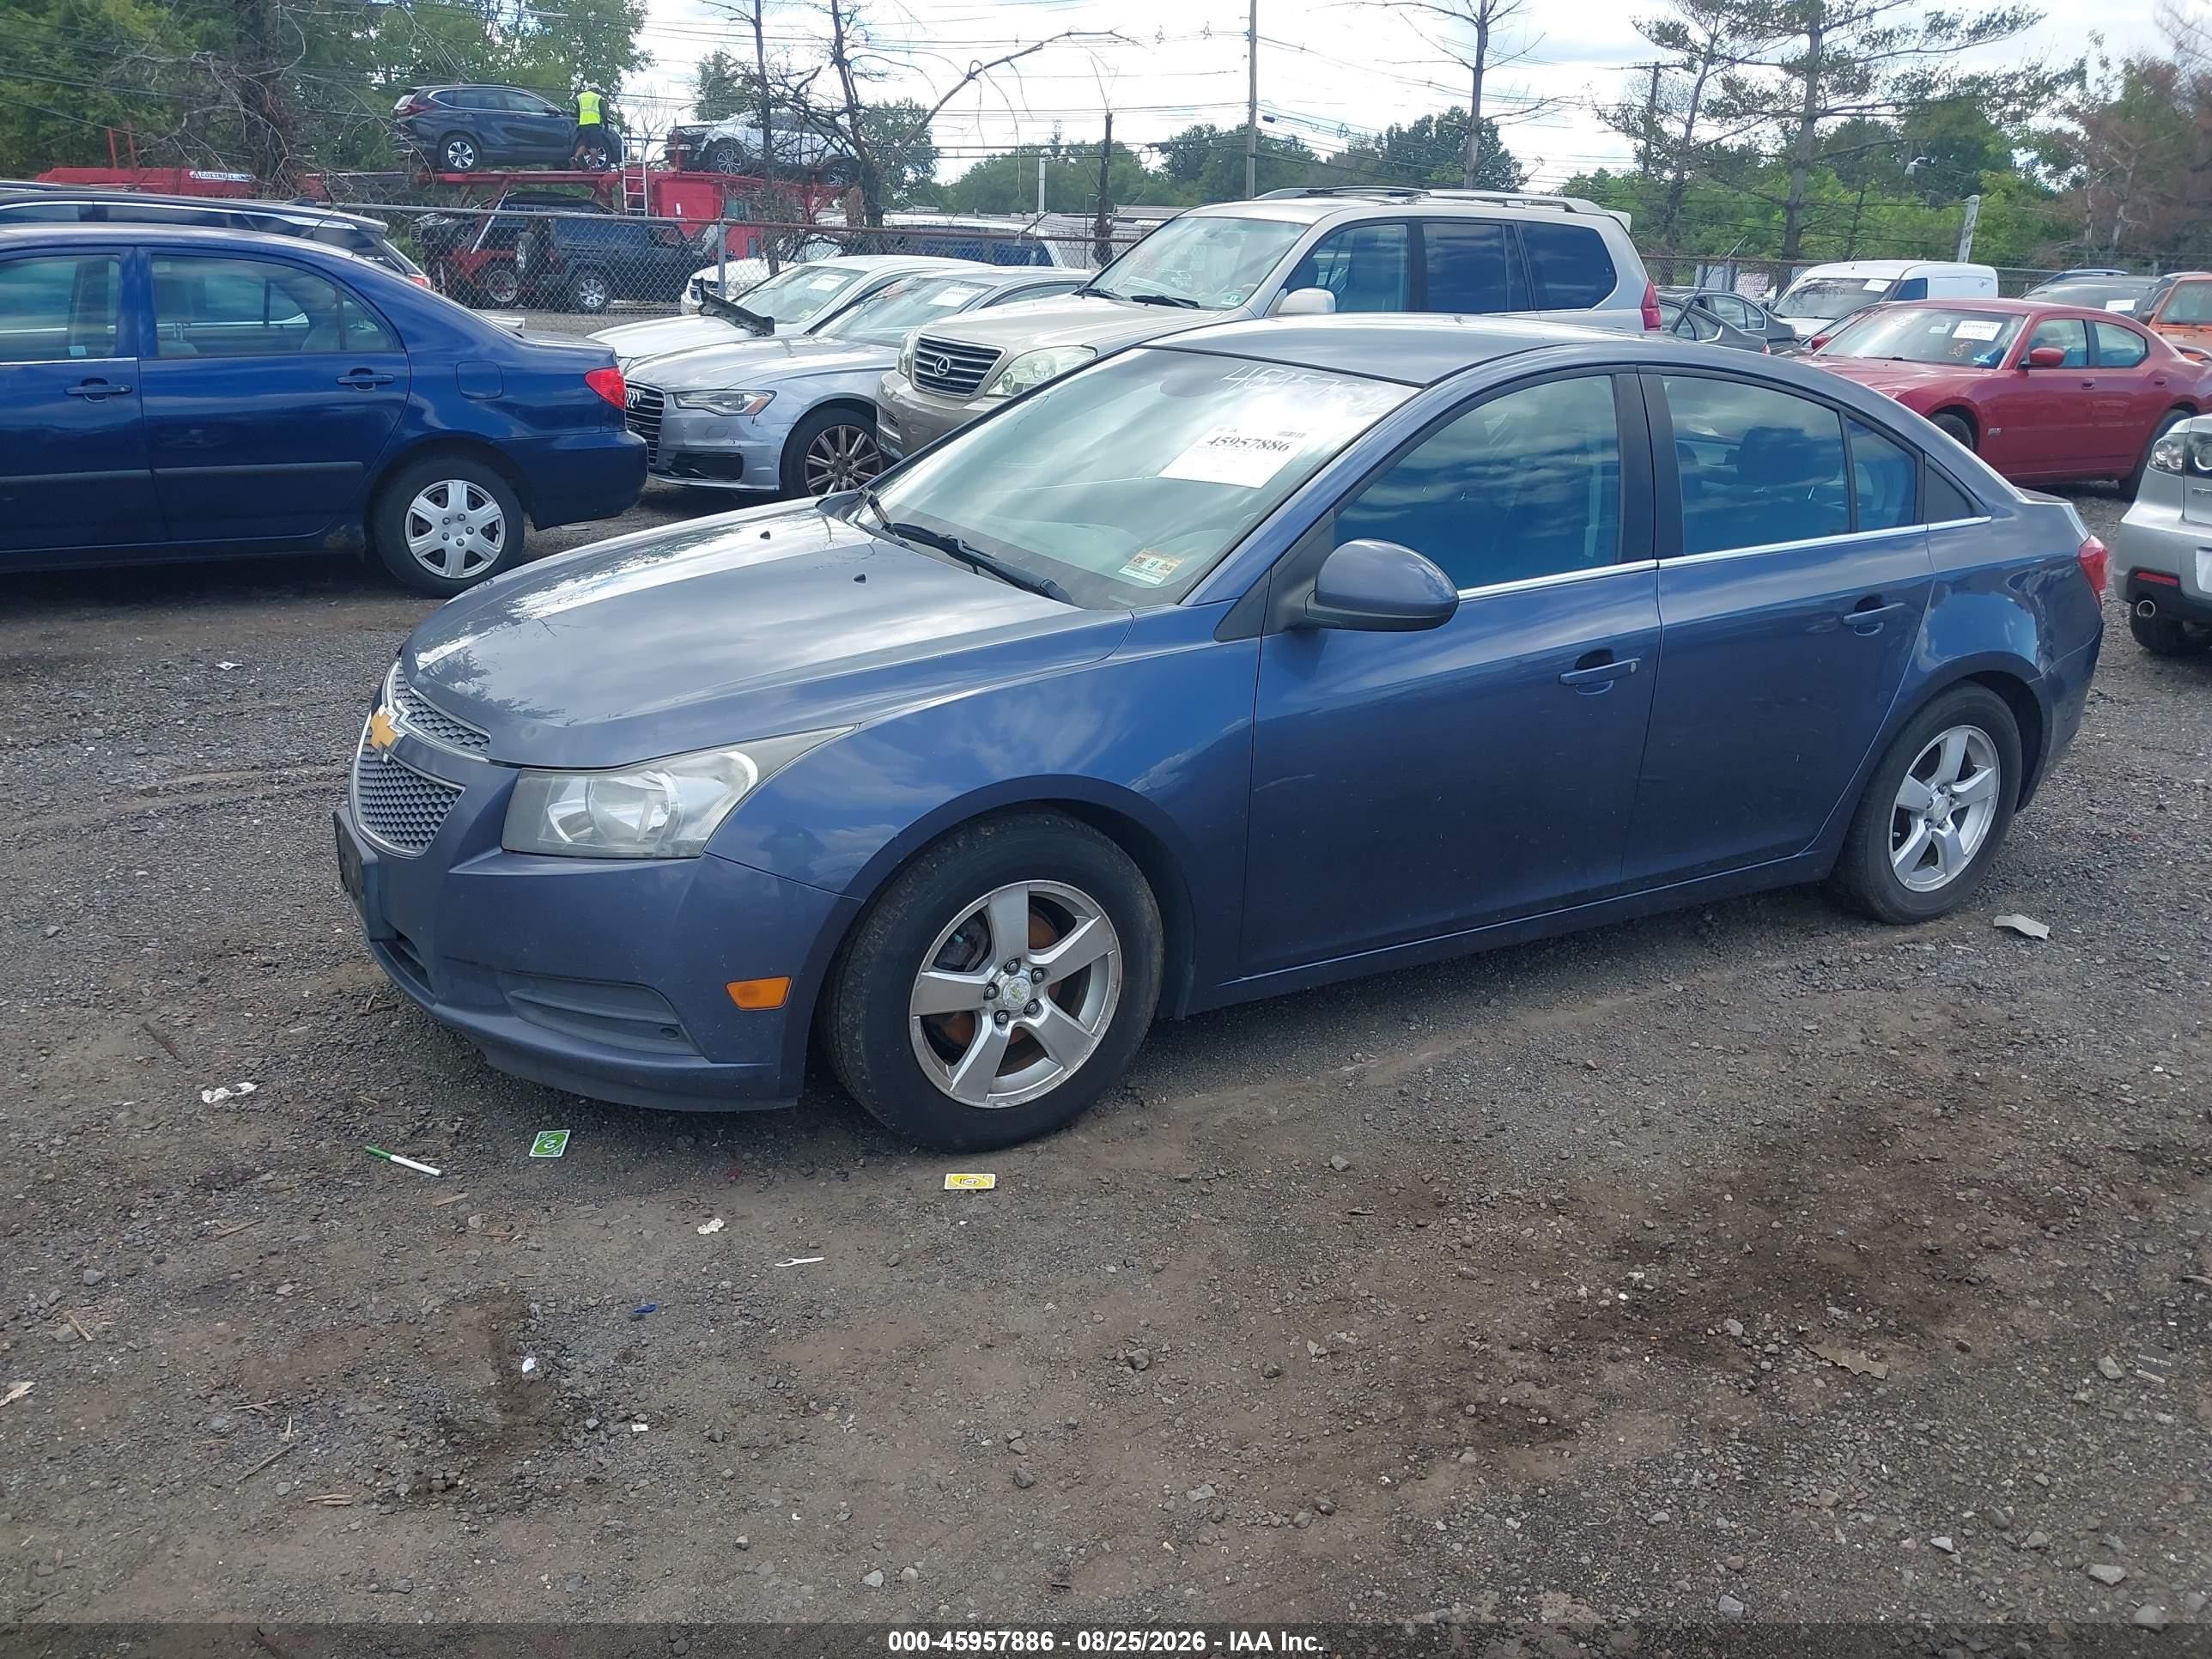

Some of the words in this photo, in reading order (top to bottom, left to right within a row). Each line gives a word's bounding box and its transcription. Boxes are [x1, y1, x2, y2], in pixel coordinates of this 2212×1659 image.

[1206, 435, 1292, 453] 45957886
[1147, 560, 1159, 569] 9
[543, 1139, 558, 1149] 2
